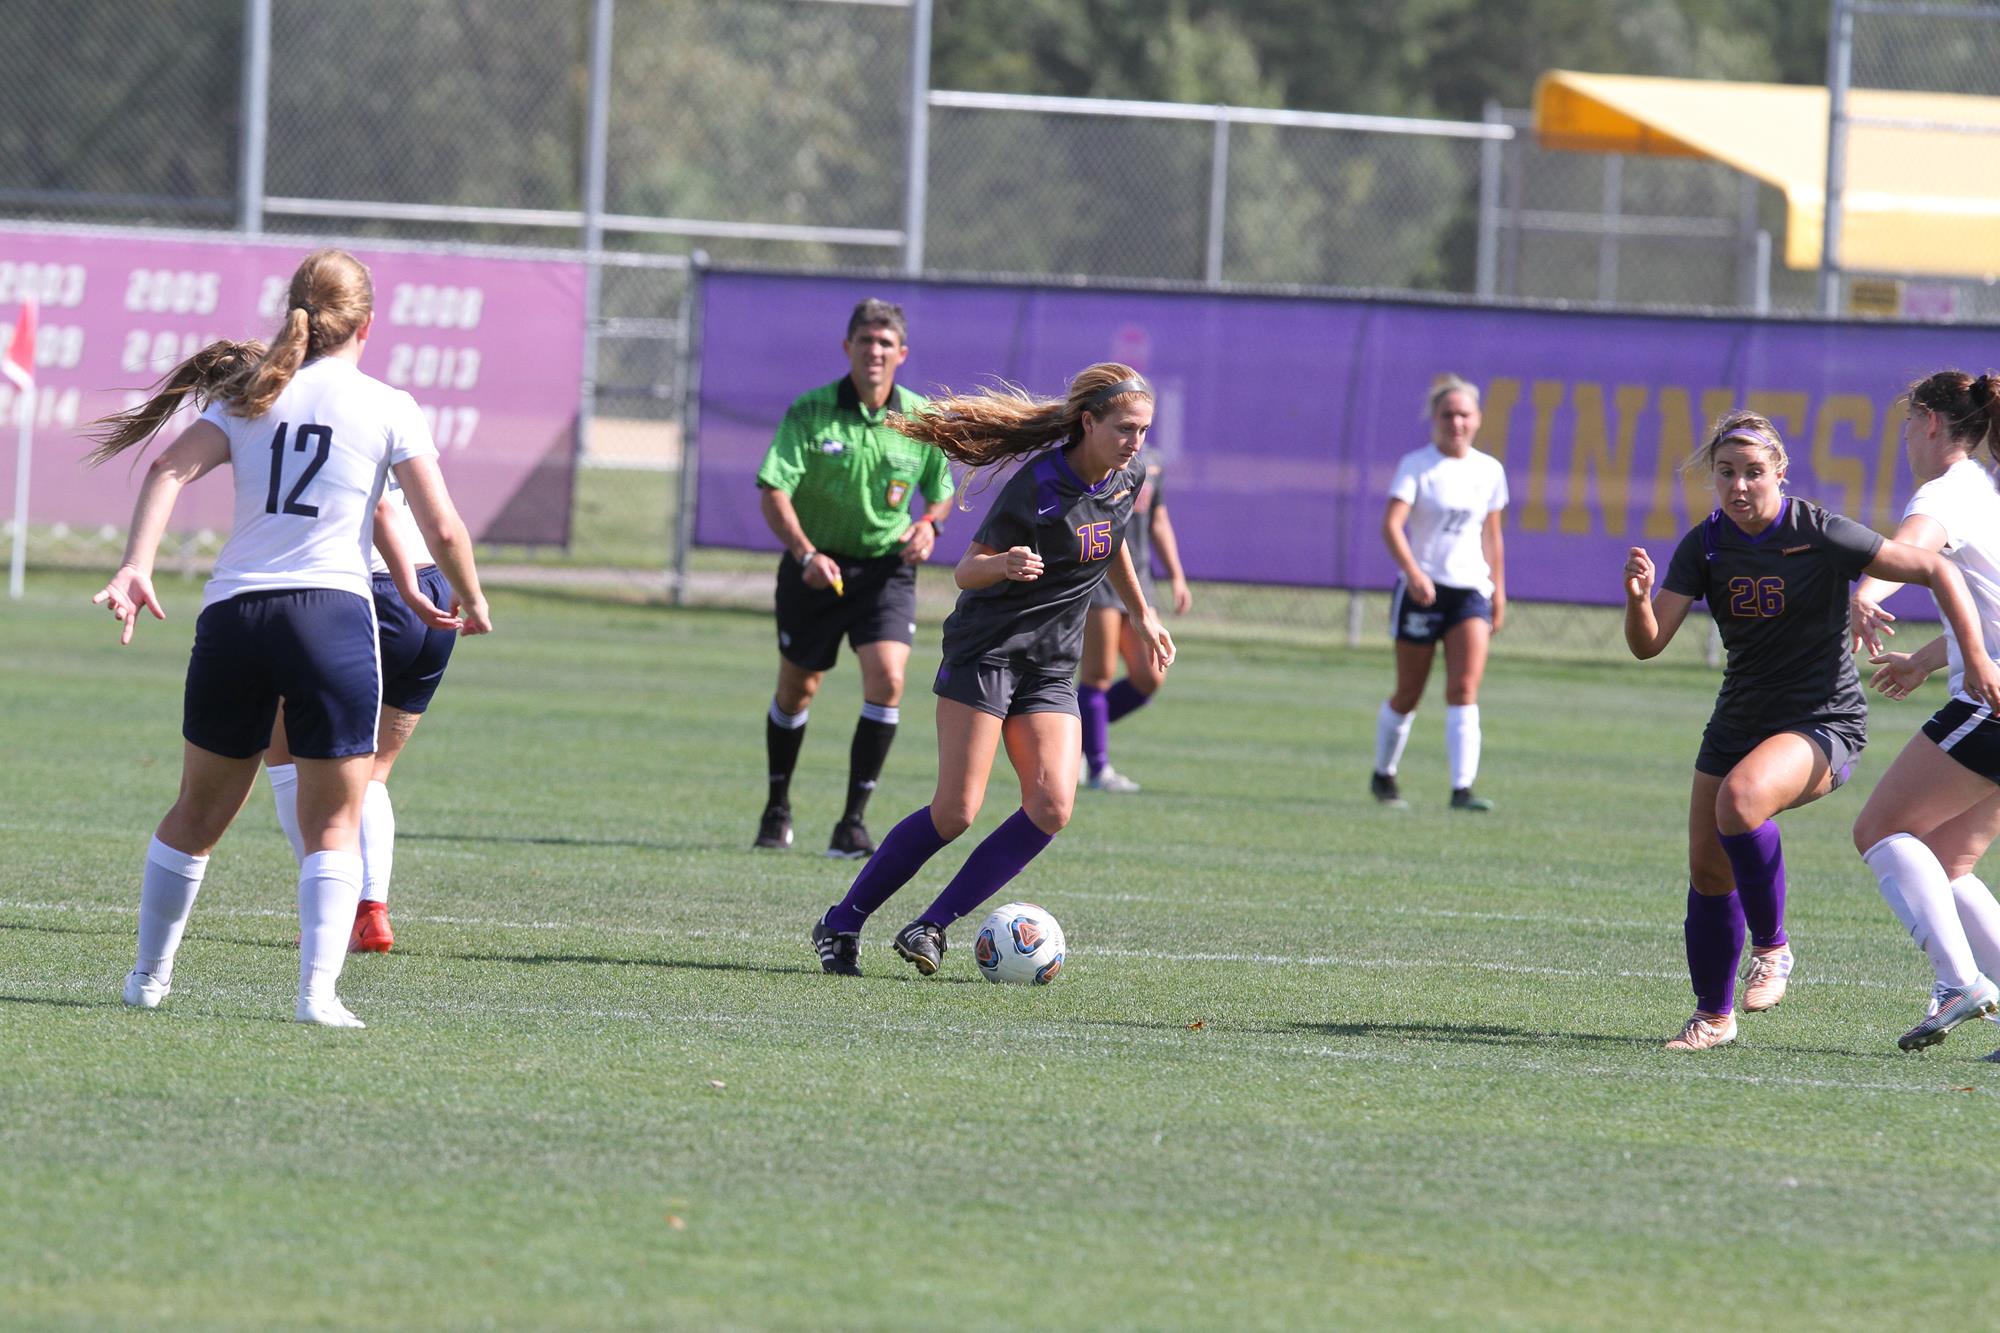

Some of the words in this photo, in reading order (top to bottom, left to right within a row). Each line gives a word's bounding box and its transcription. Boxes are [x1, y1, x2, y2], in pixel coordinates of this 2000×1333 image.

[0, 321, 84, 369] 09
[386, 343, 482, 391] 2013
[0, 383, 80, 430] 214
[424, 404, 481, 449] 17
[265, 422, 334, 518] 12
[1076, 520, 1112, 562] 15
[1728, 576, 1785, 618] 26
